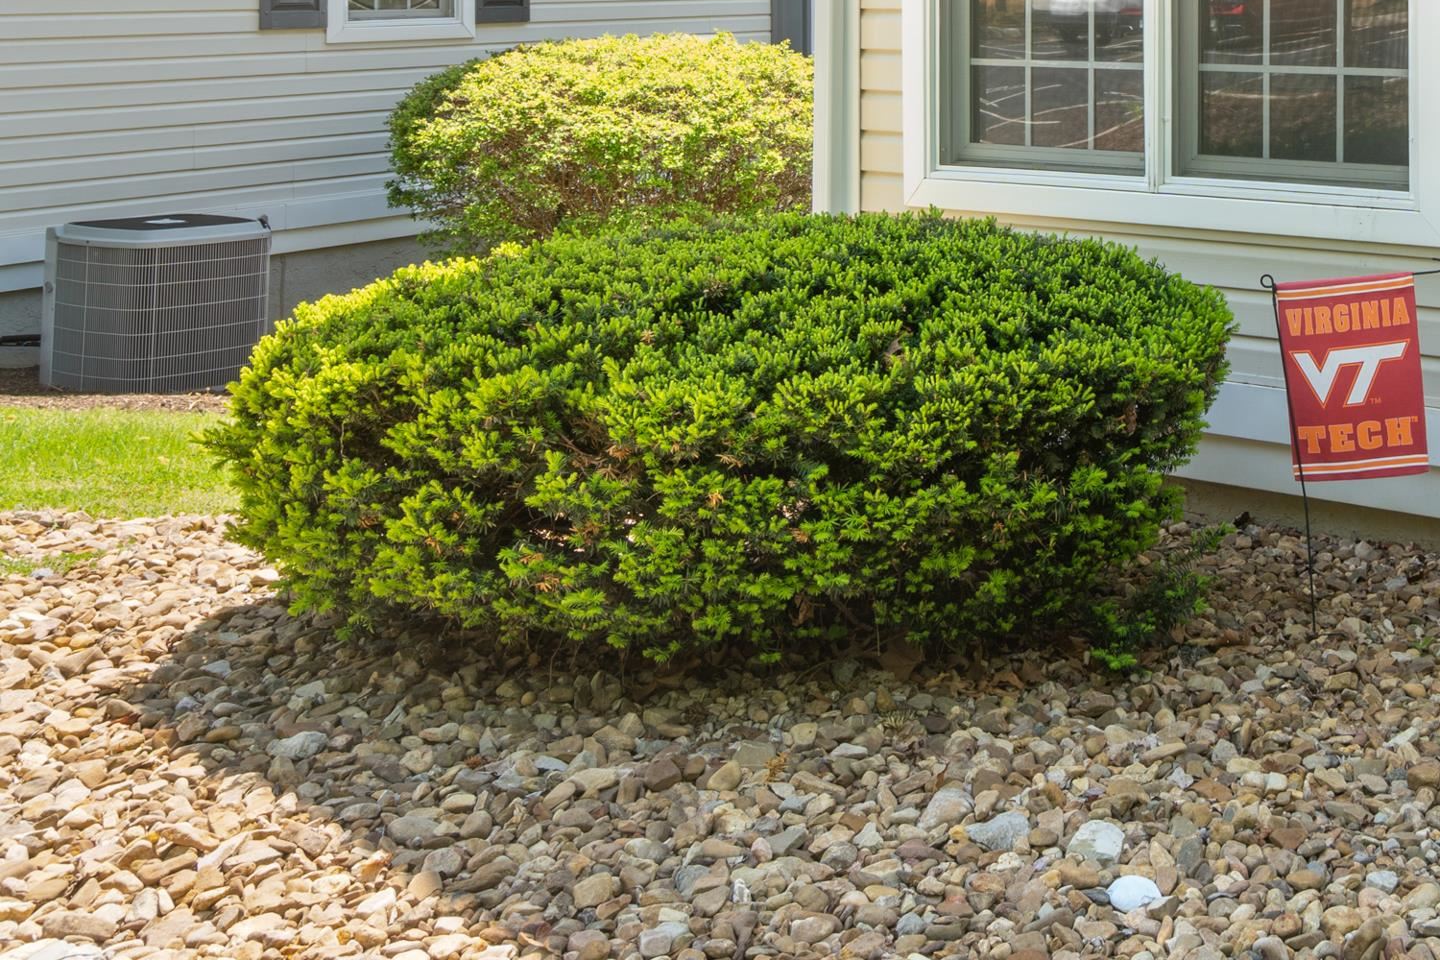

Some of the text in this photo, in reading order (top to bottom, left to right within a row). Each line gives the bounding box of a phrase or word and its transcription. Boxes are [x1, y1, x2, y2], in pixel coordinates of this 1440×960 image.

[1285, 296, 1411, 337] VIRGINIA
[1288, 338, 1411, 409] VT
[1297, 416, 1414, 454] TECH
